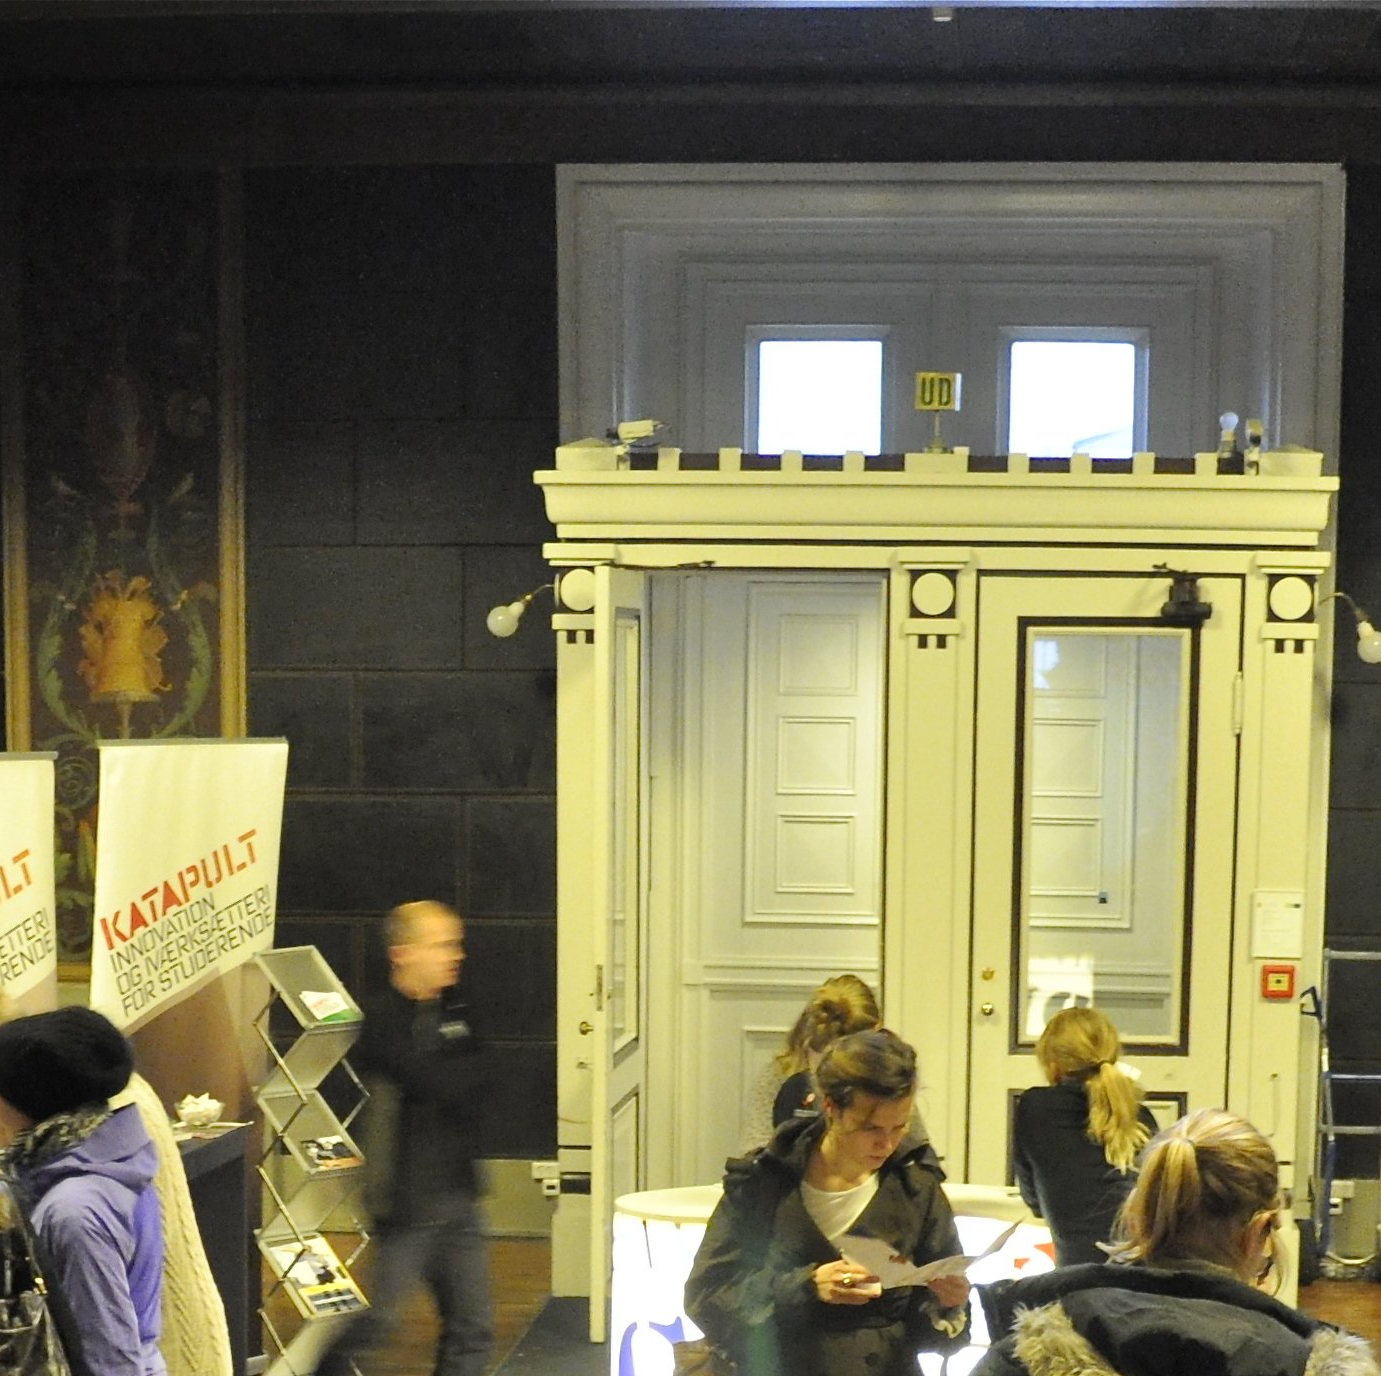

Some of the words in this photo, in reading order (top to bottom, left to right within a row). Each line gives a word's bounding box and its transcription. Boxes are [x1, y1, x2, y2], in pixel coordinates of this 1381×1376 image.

[921, 377, 952, 406] UD
[100, 829, 256, 951] KATAPULT
[109, 892, 216, 973] INNOVATION
[116, 963, 143, 996] OG
[144, 884, 271, 977] IVÆRKSÆTTERI
[121, 979, 157, 1018] FOR
[158, 906, 274, 993] STUDERENDE
